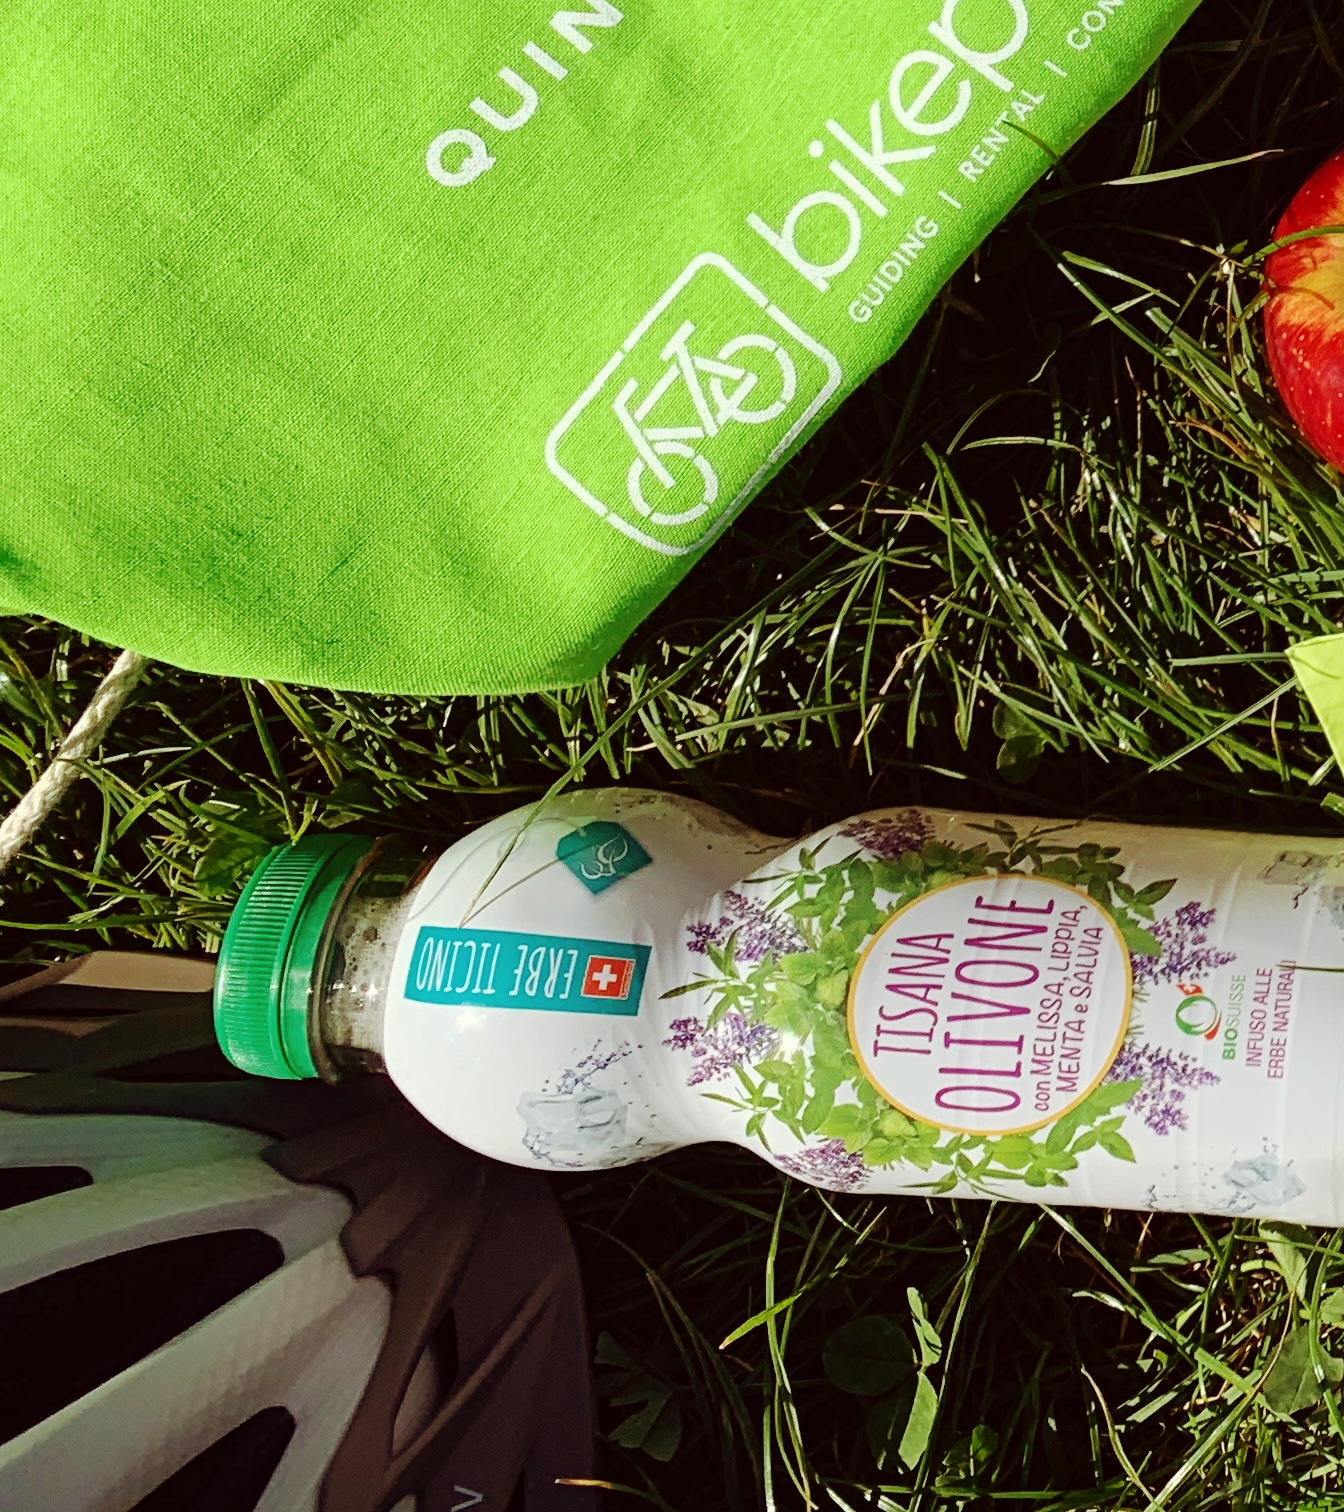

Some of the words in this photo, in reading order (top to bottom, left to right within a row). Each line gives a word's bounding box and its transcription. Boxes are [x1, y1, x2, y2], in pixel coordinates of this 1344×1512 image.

[847, 215, 941, 326] GUIDING
[957, 89, 1047, 185] RENTAL
[416, 935, 502, 992] TICINO
[509, 943, 578, 1001] ERBE
[1047, 904, 1088, 973] LIPPIA,
[1069, 926, 1104, 999] SALVIA
[873, 931, 955, 1059] TISANA
[935, 895, 1055, 1113] OLIVONE
[1030, 977, 1068, 1078] MELISSA,
[1222, 973, 1247, 1060] BIOSUISSE
[1245, 1007, 1267, 1068] INFUSO
[1256, 967, 1273, 1005] ALLE
[1273, 960, 1297, 1033] NATURALI
[1056, 1019, 1087, 1093] MENTA
[1267, 1036, 1287, 1079] ERBE
[1034, 1079, 1051, 1112] con
